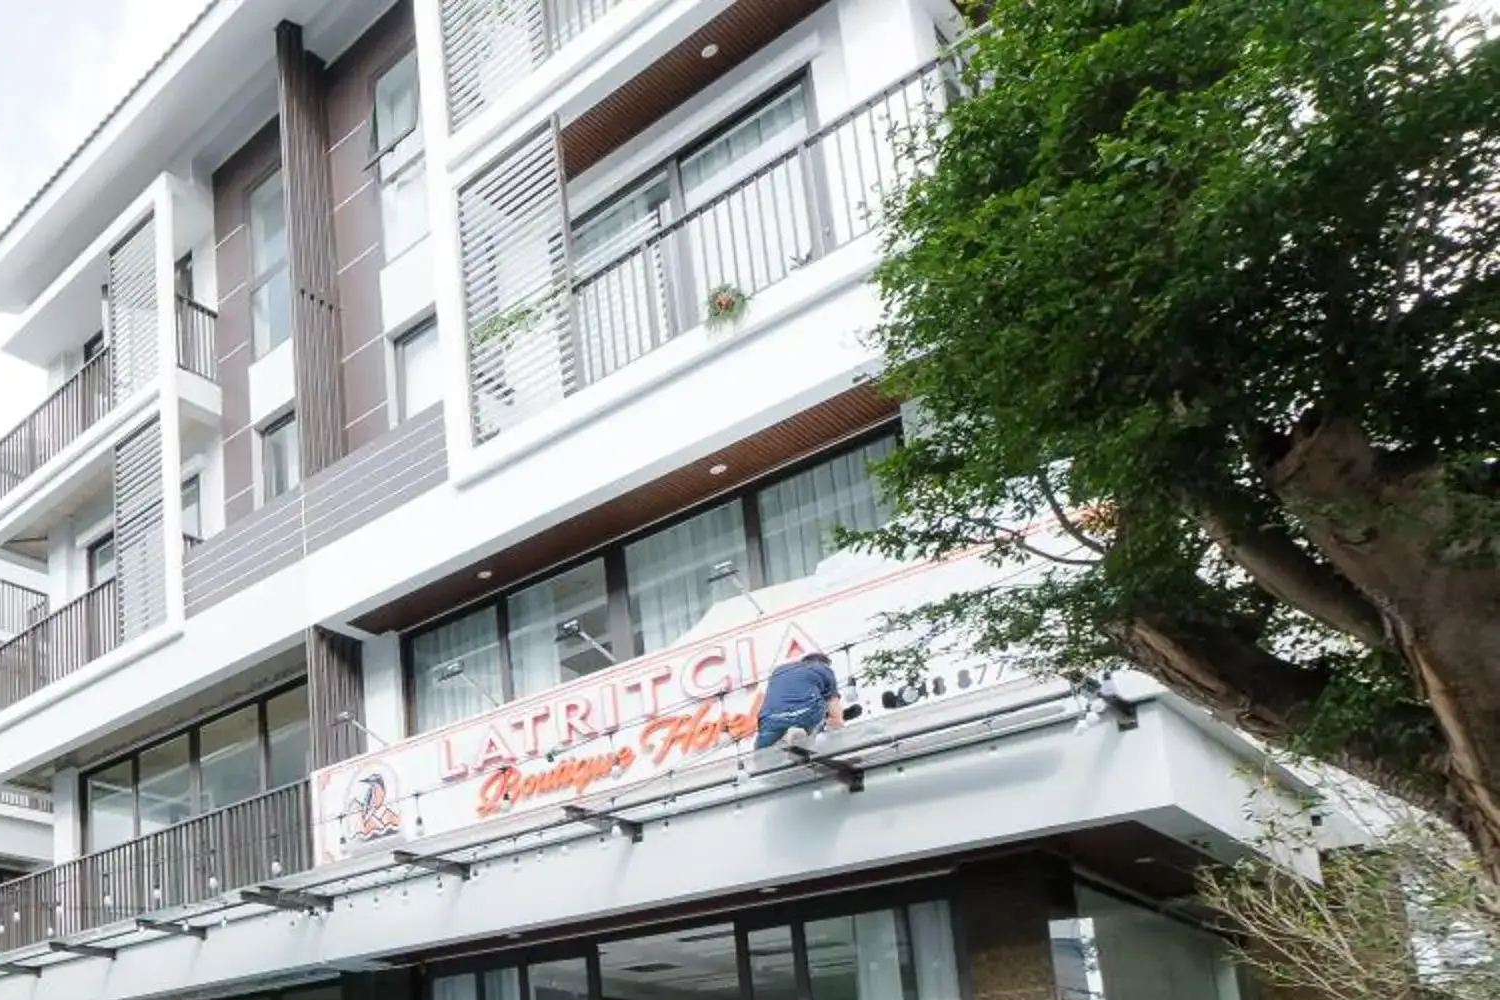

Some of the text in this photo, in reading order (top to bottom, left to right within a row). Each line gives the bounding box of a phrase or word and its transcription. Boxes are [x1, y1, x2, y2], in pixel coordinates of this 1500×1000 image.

[438, 620, 825, 783] LATRITCIA
[476, 743, 636, 818] Boutique
[638, 684, 762, 766] Hotel
